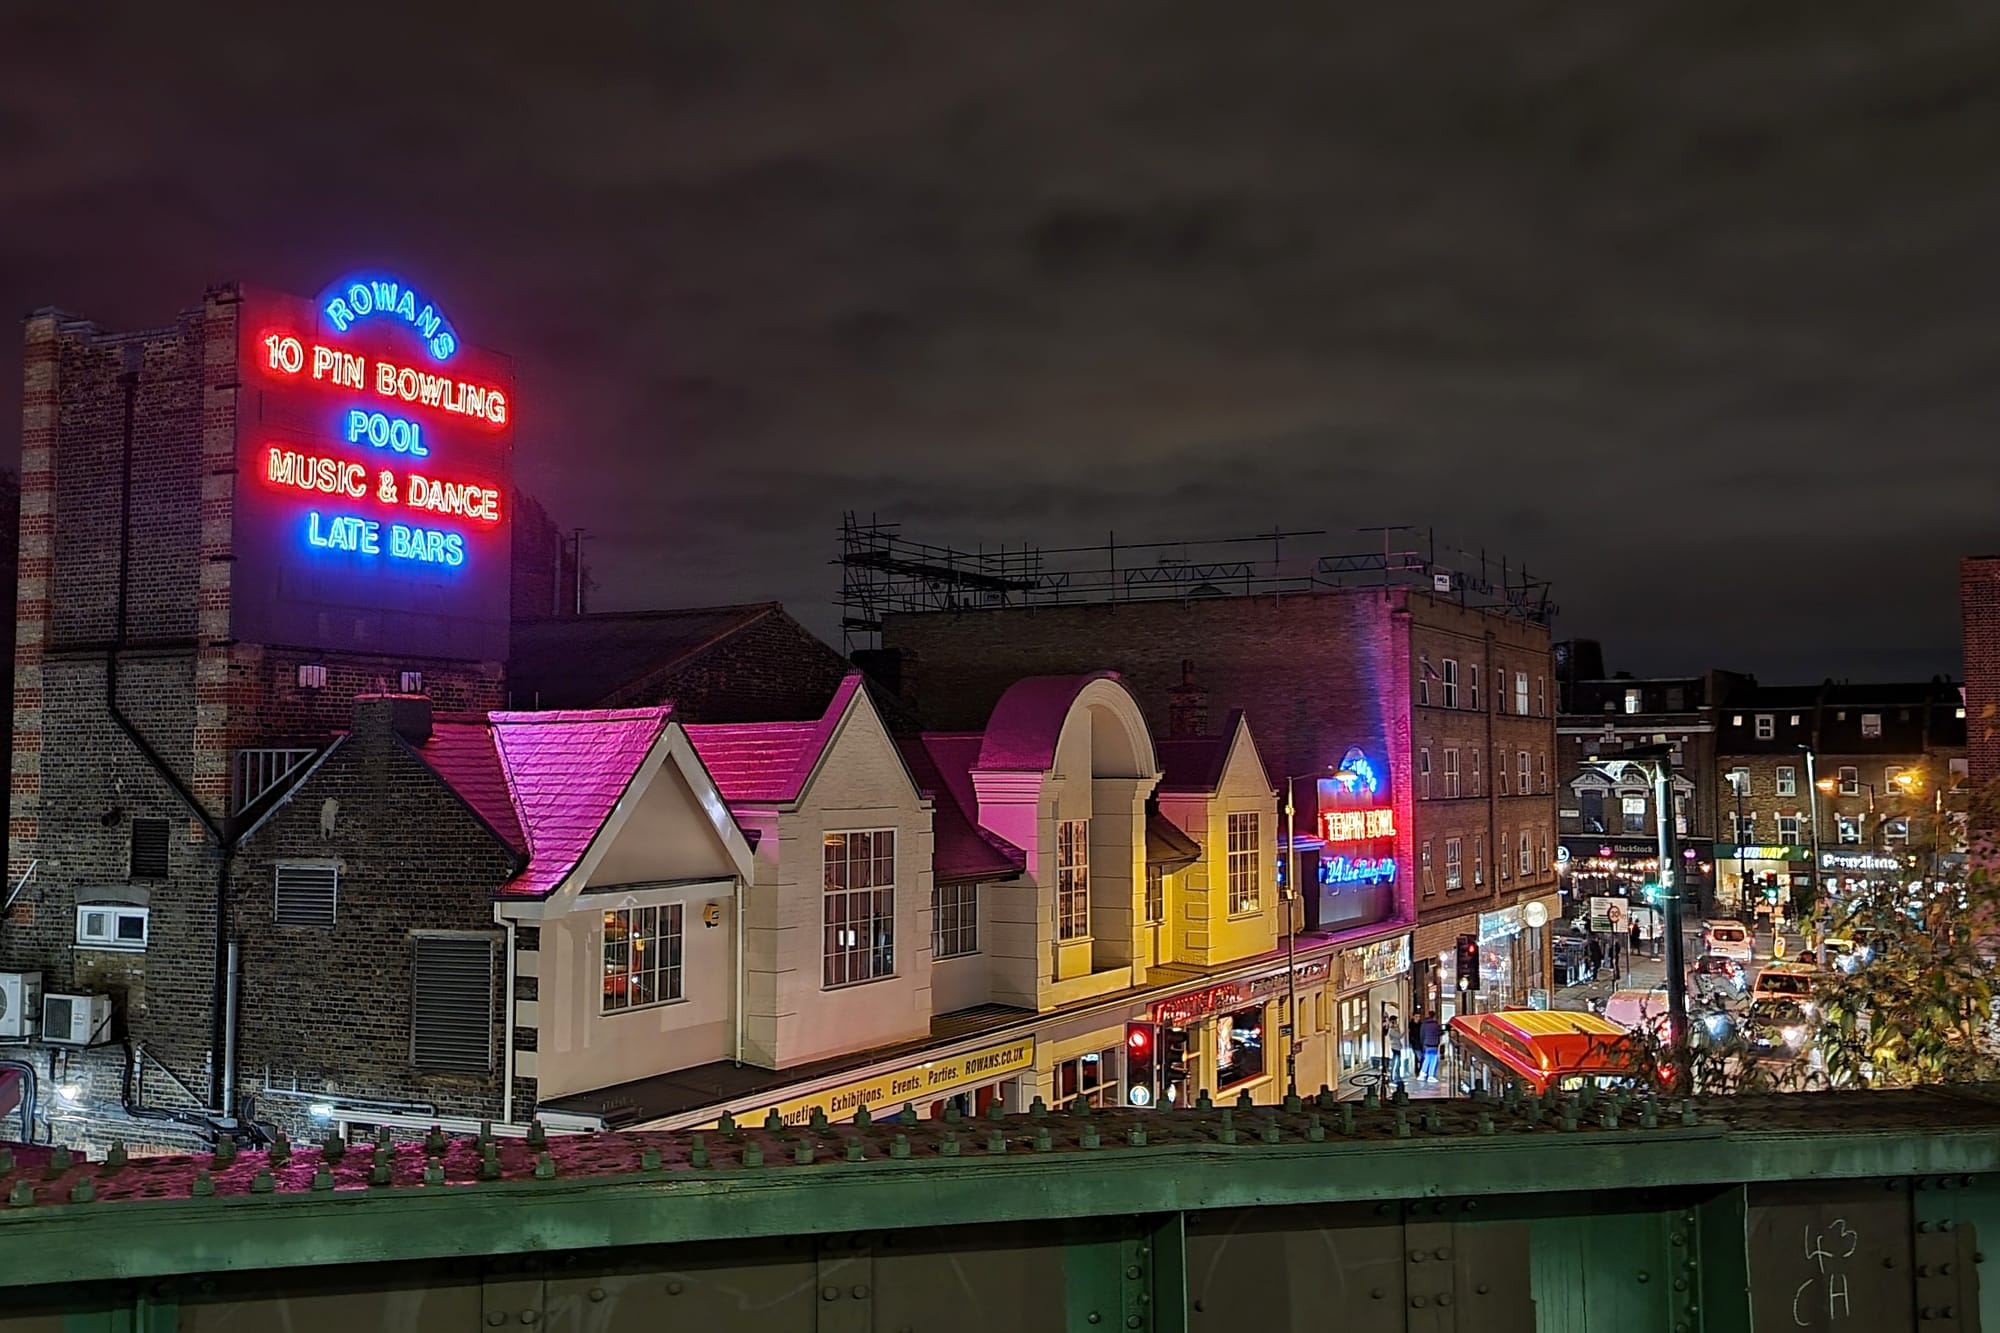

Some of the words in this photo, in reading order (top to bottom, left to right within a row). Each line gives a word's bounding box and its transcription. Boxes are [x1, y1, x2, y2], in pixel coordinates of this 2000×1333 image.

[326, 281, 456, 360] ROWANS
[266, 334, 303, 372] 10
[313, 345, 365, 388] PIN
[376, 362, 506, 423] BOWLING
[349, 410, 428, 456] POOL
[268, 448, 366, 498] MUSIC
[378, 470, 398, 503] &
[408, 474, 498, 520] DANCE
[309, 512, 380, 554] LATE
[390, 525, 463, 565] BARS
[1324, 811, 1365, 841] TENPIN
[1366, 809, 1396, 838] BOWL
[831, 1088, 884, 1112] Exhibitions.
[892, 1077, 922, 1095] Events.
[928, 1067, 959, 1085] Parties.
[965, 1046, 1025, 1075] ROWANS.CO.UK
